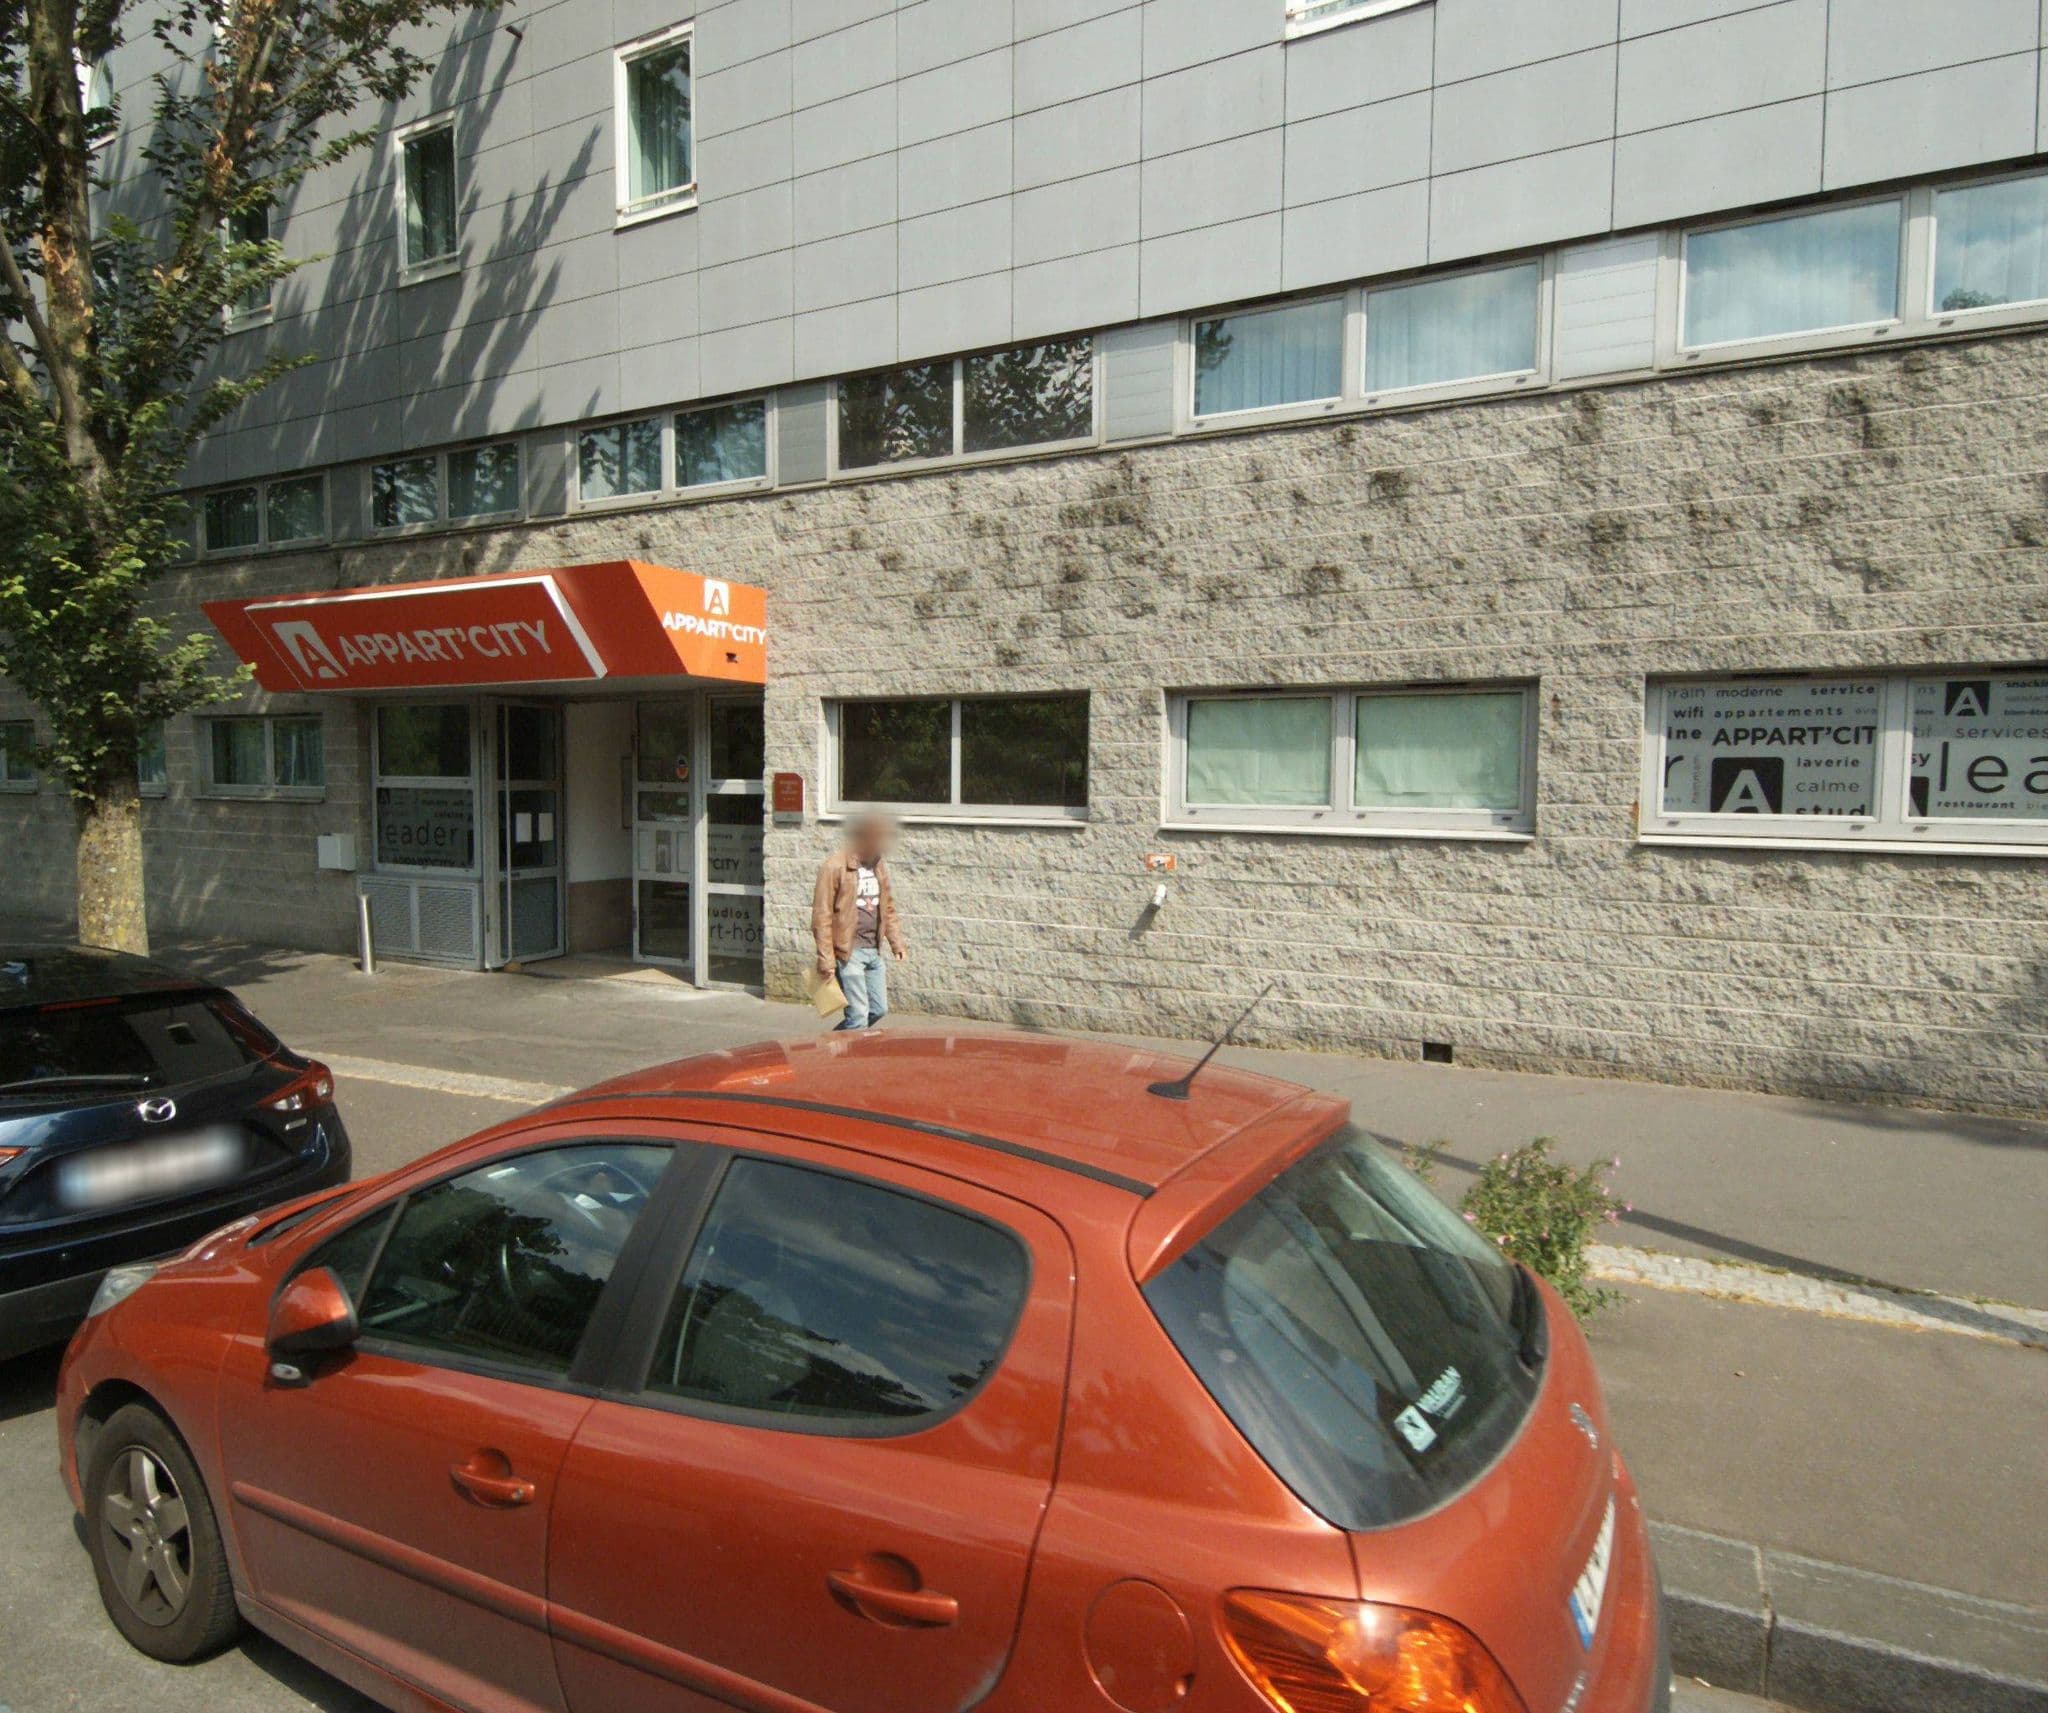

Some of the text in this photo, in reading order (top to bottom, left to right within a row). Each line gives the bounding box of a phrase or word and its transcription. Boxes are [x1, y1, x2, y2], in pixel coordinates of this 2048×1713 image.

[662, 611, 767, 645] APPART'CITY
[339, 620, 552, 666] APPART'CITY
[1716, 686, 1784, 698] moderne
[1810, 683, 1875, 696] service
[1673, 703, 1704, 720] wifi
[1714, 704, 1843, 720] appartements
[1796, 756, 1860, 768] laverie
[1796, 778, 1860, 793] calme
[1937, 800, 2016, 810] restaurant
[385, 820, 458, 846] eader
